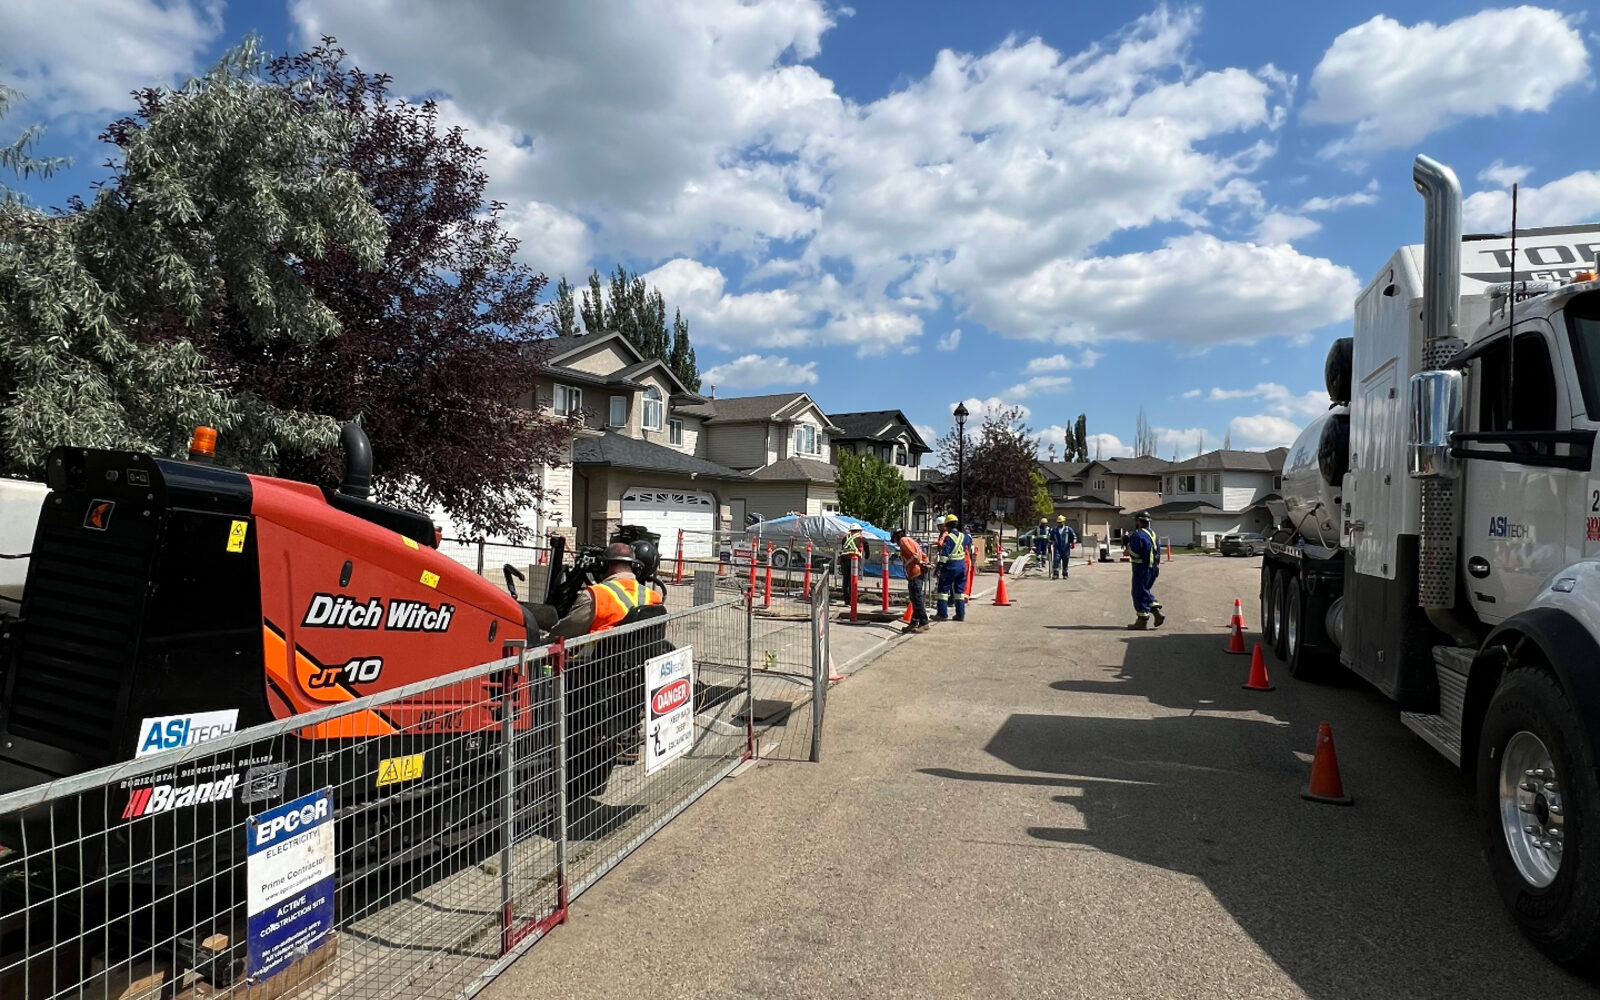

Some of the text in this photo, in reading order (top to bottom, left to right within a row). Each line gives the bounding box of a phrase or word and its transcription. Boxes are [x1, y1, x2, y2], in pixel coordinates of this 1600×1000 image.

[305, 595, 453, 630] Ditch Witch
[657, 683, 687, 709] DANGER
[143, 773, 240, 815] Brandt
[256, 797, 329, 846] EPCOR
[266, 829, 319, 859] ELECTRICITY
[261, 856, 326, 893] Prime Contractor
[260, 896, 326, 938] CONSTRUCTION SITE
[276, 895, 307, 918] ACTIVE
